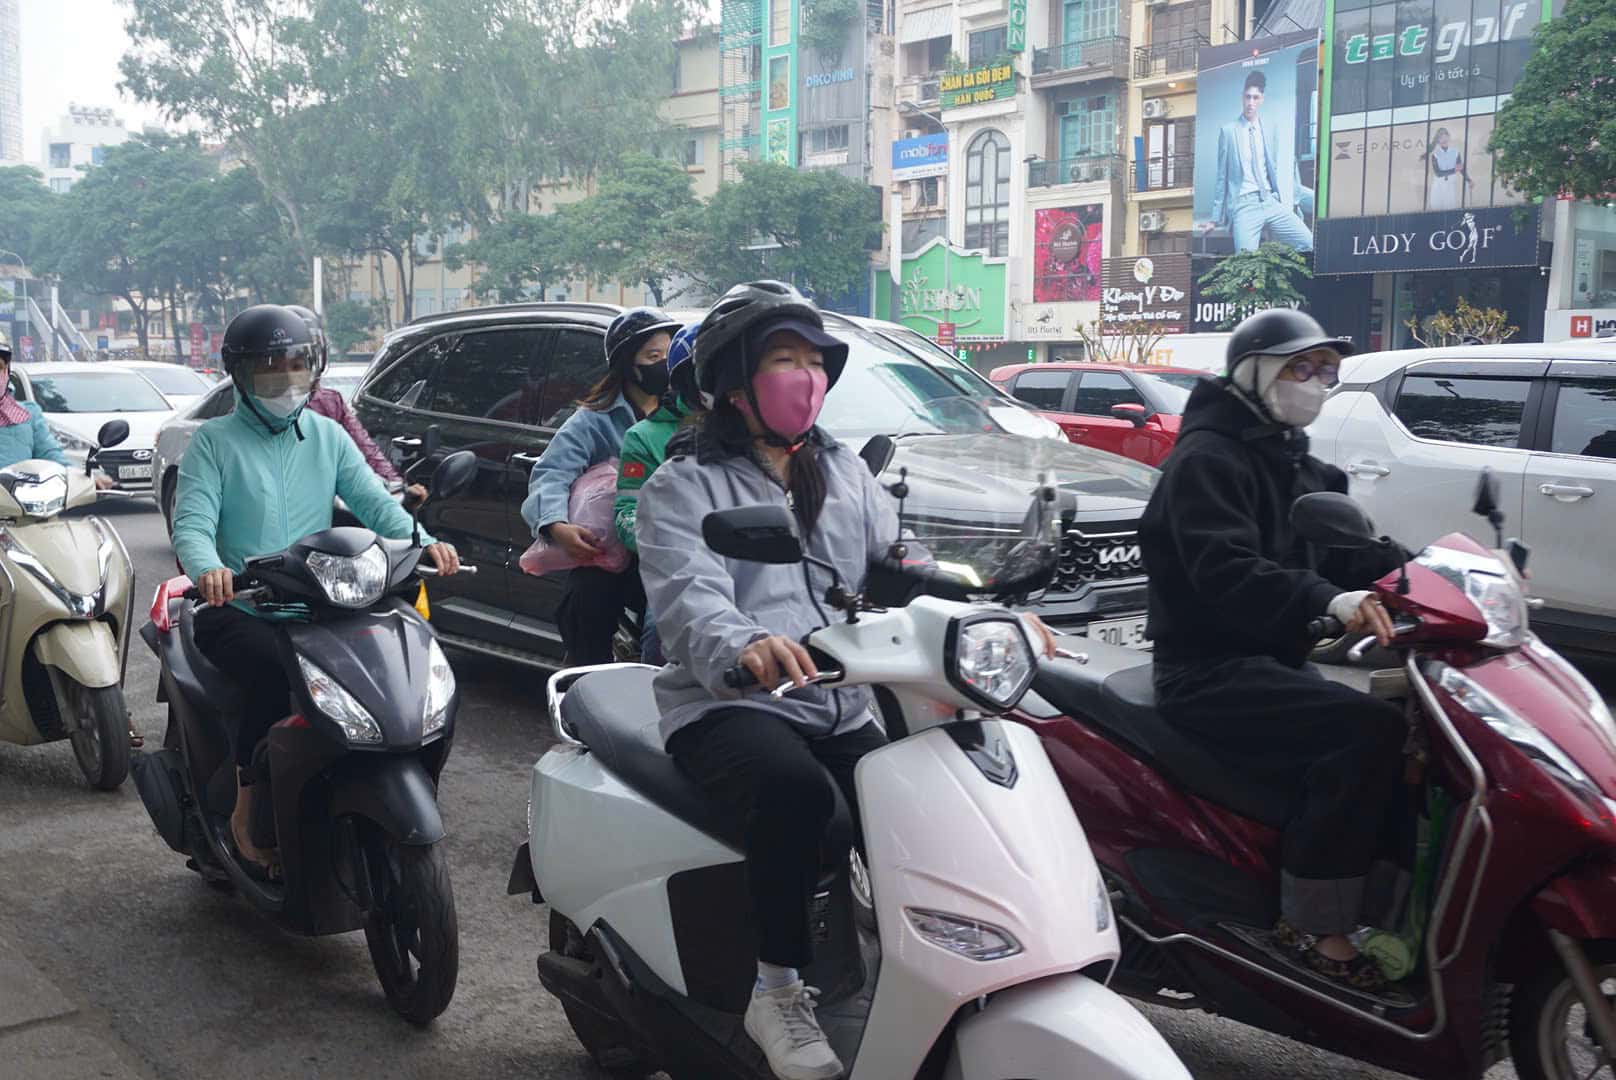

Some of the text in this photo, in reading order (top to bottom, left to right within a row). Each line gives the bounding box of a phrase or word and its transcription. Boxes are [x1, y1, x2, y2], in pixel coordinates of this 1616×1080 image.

[1344, 3, 1528, 65] tat golf
[1400, 73, 1416, 88] Uy
[1352, 233, 1416, 256] LADY
[1144, 286, 1158, 305] Y
[1098, 545, 1142, 565] KIA
